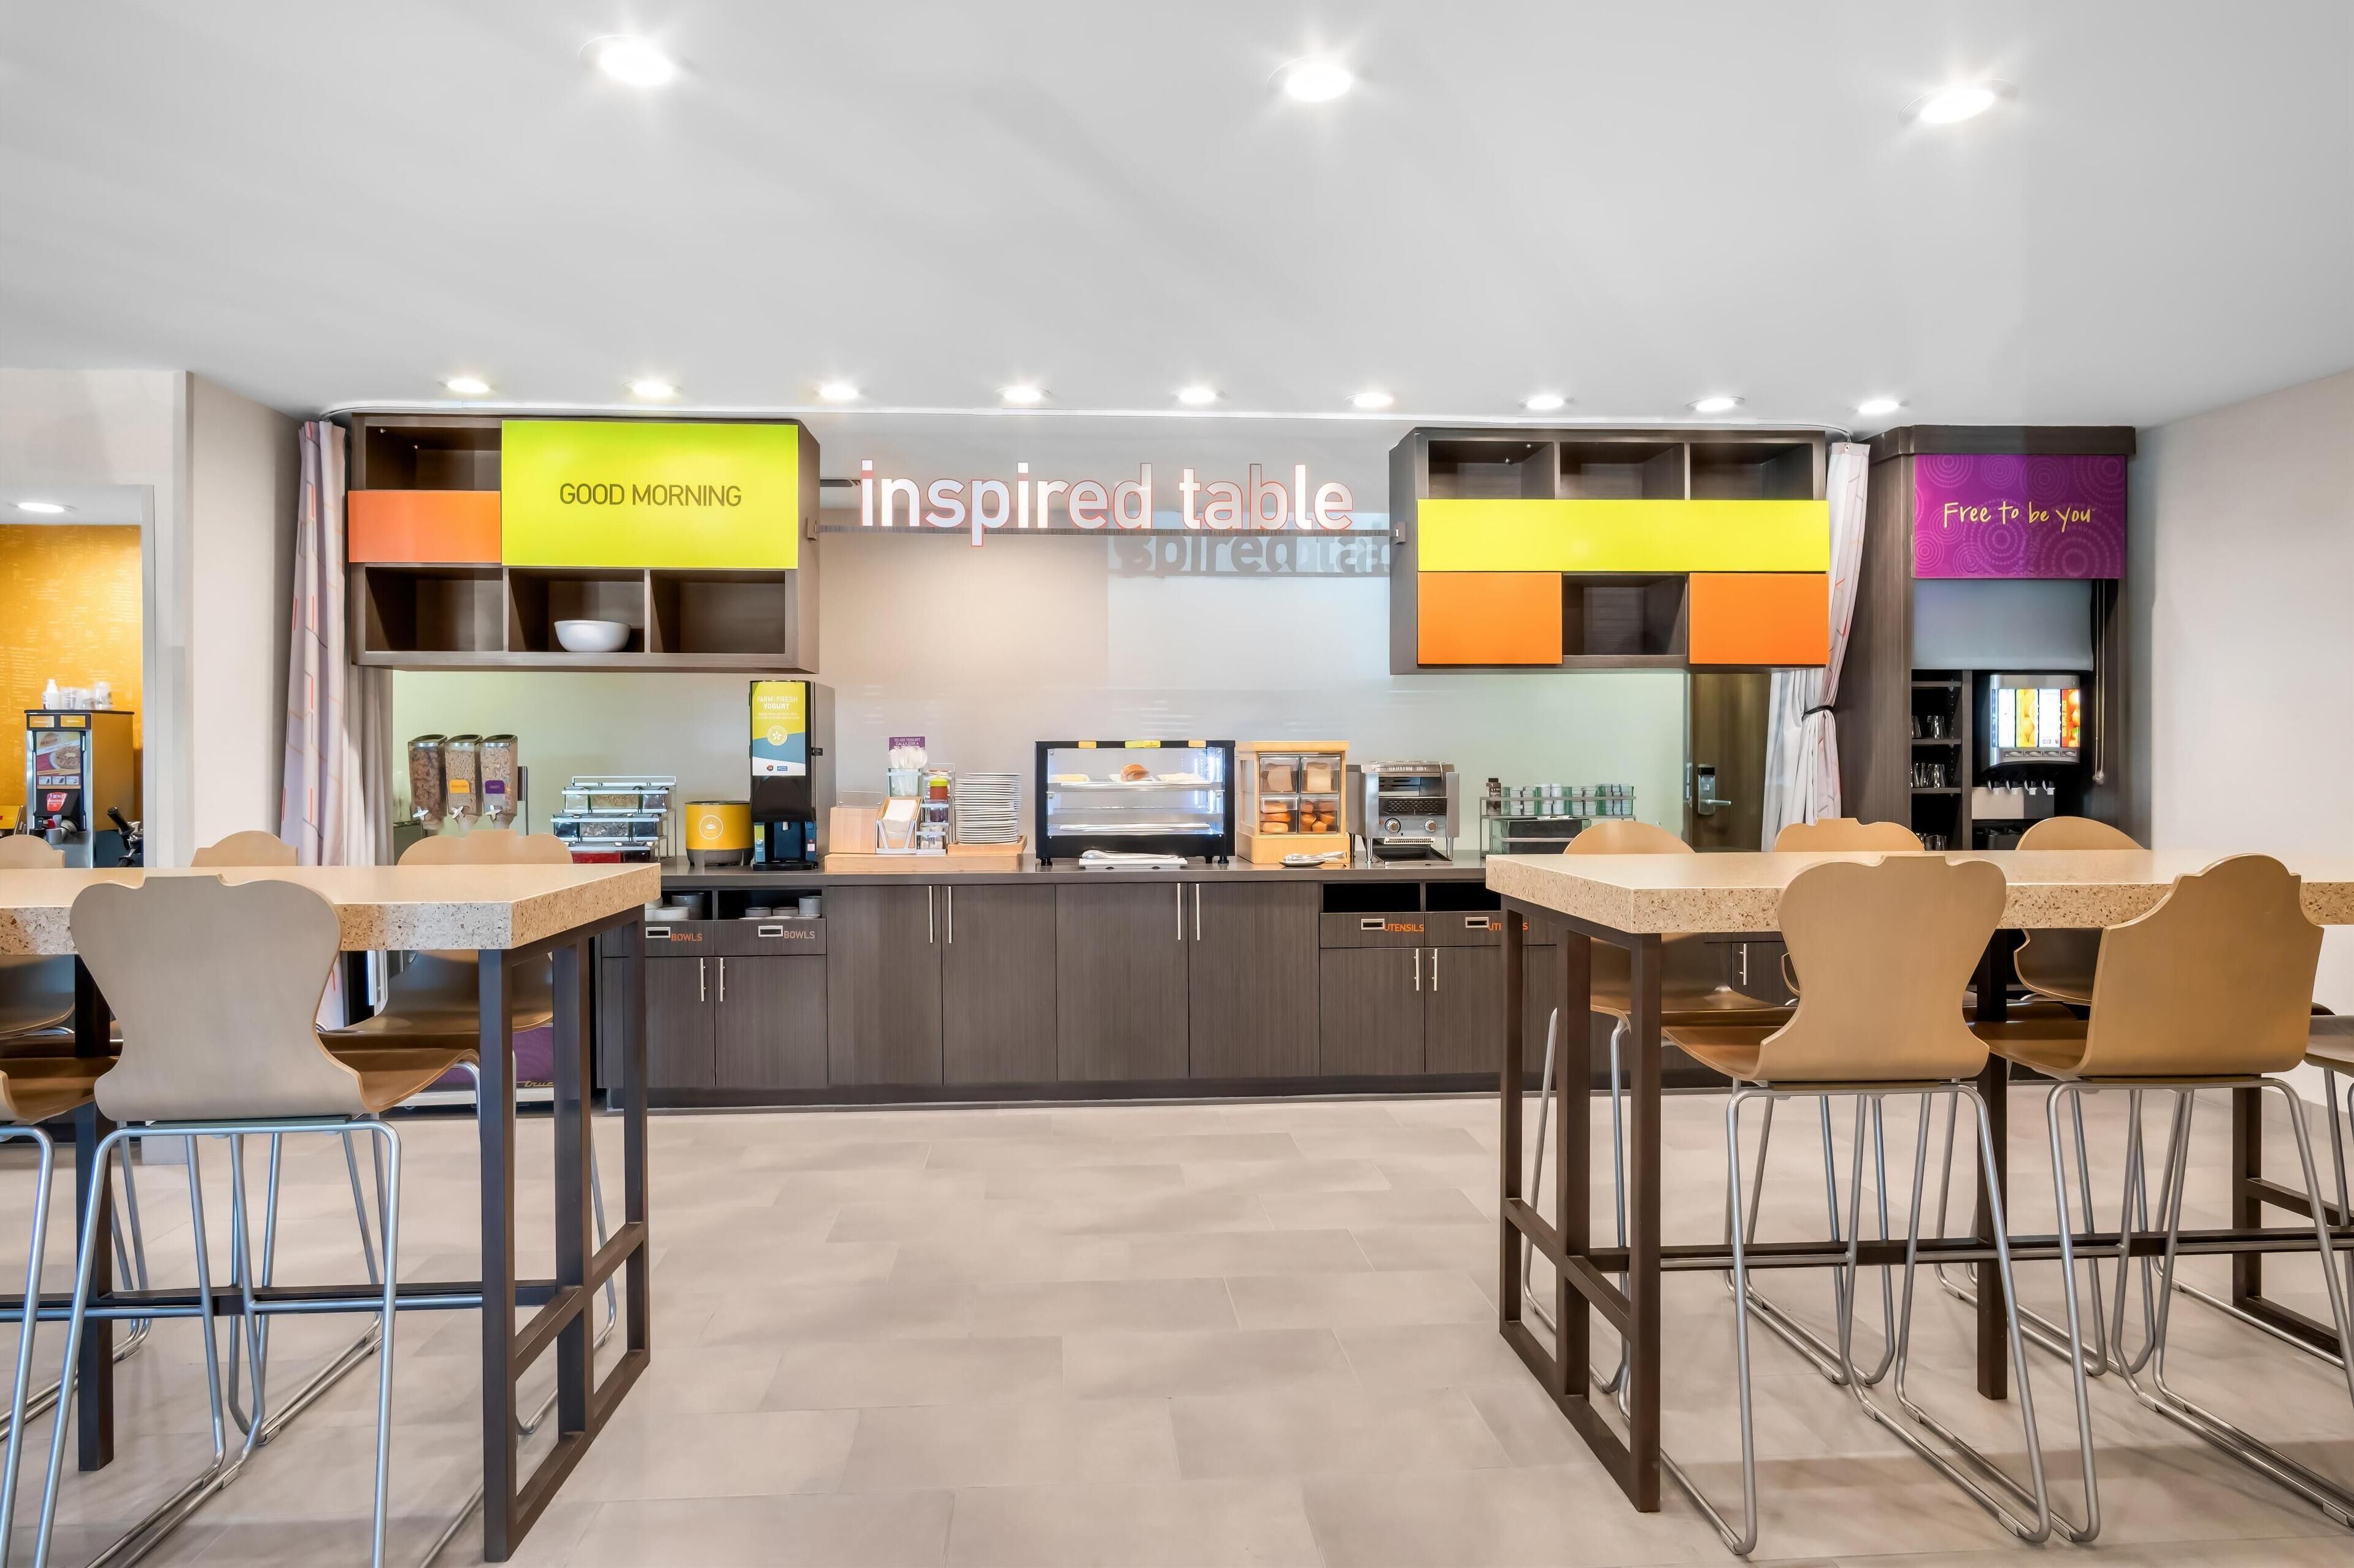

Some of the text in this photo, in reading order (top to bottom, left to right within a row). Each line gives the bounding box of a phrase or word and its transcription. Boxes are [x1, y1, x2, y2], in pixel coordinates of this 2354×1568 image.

[560, 483, 742, 507] GOOD MORNING
[861, 458, 1353, 547] inspired table
[1944, 501, 2091, 533] Free to be you
[783, 931, 815, 939] BOWLS
[1383, 923, 1424, 932] UTENSILS
[671, 933, 702, 942] BOWLS
